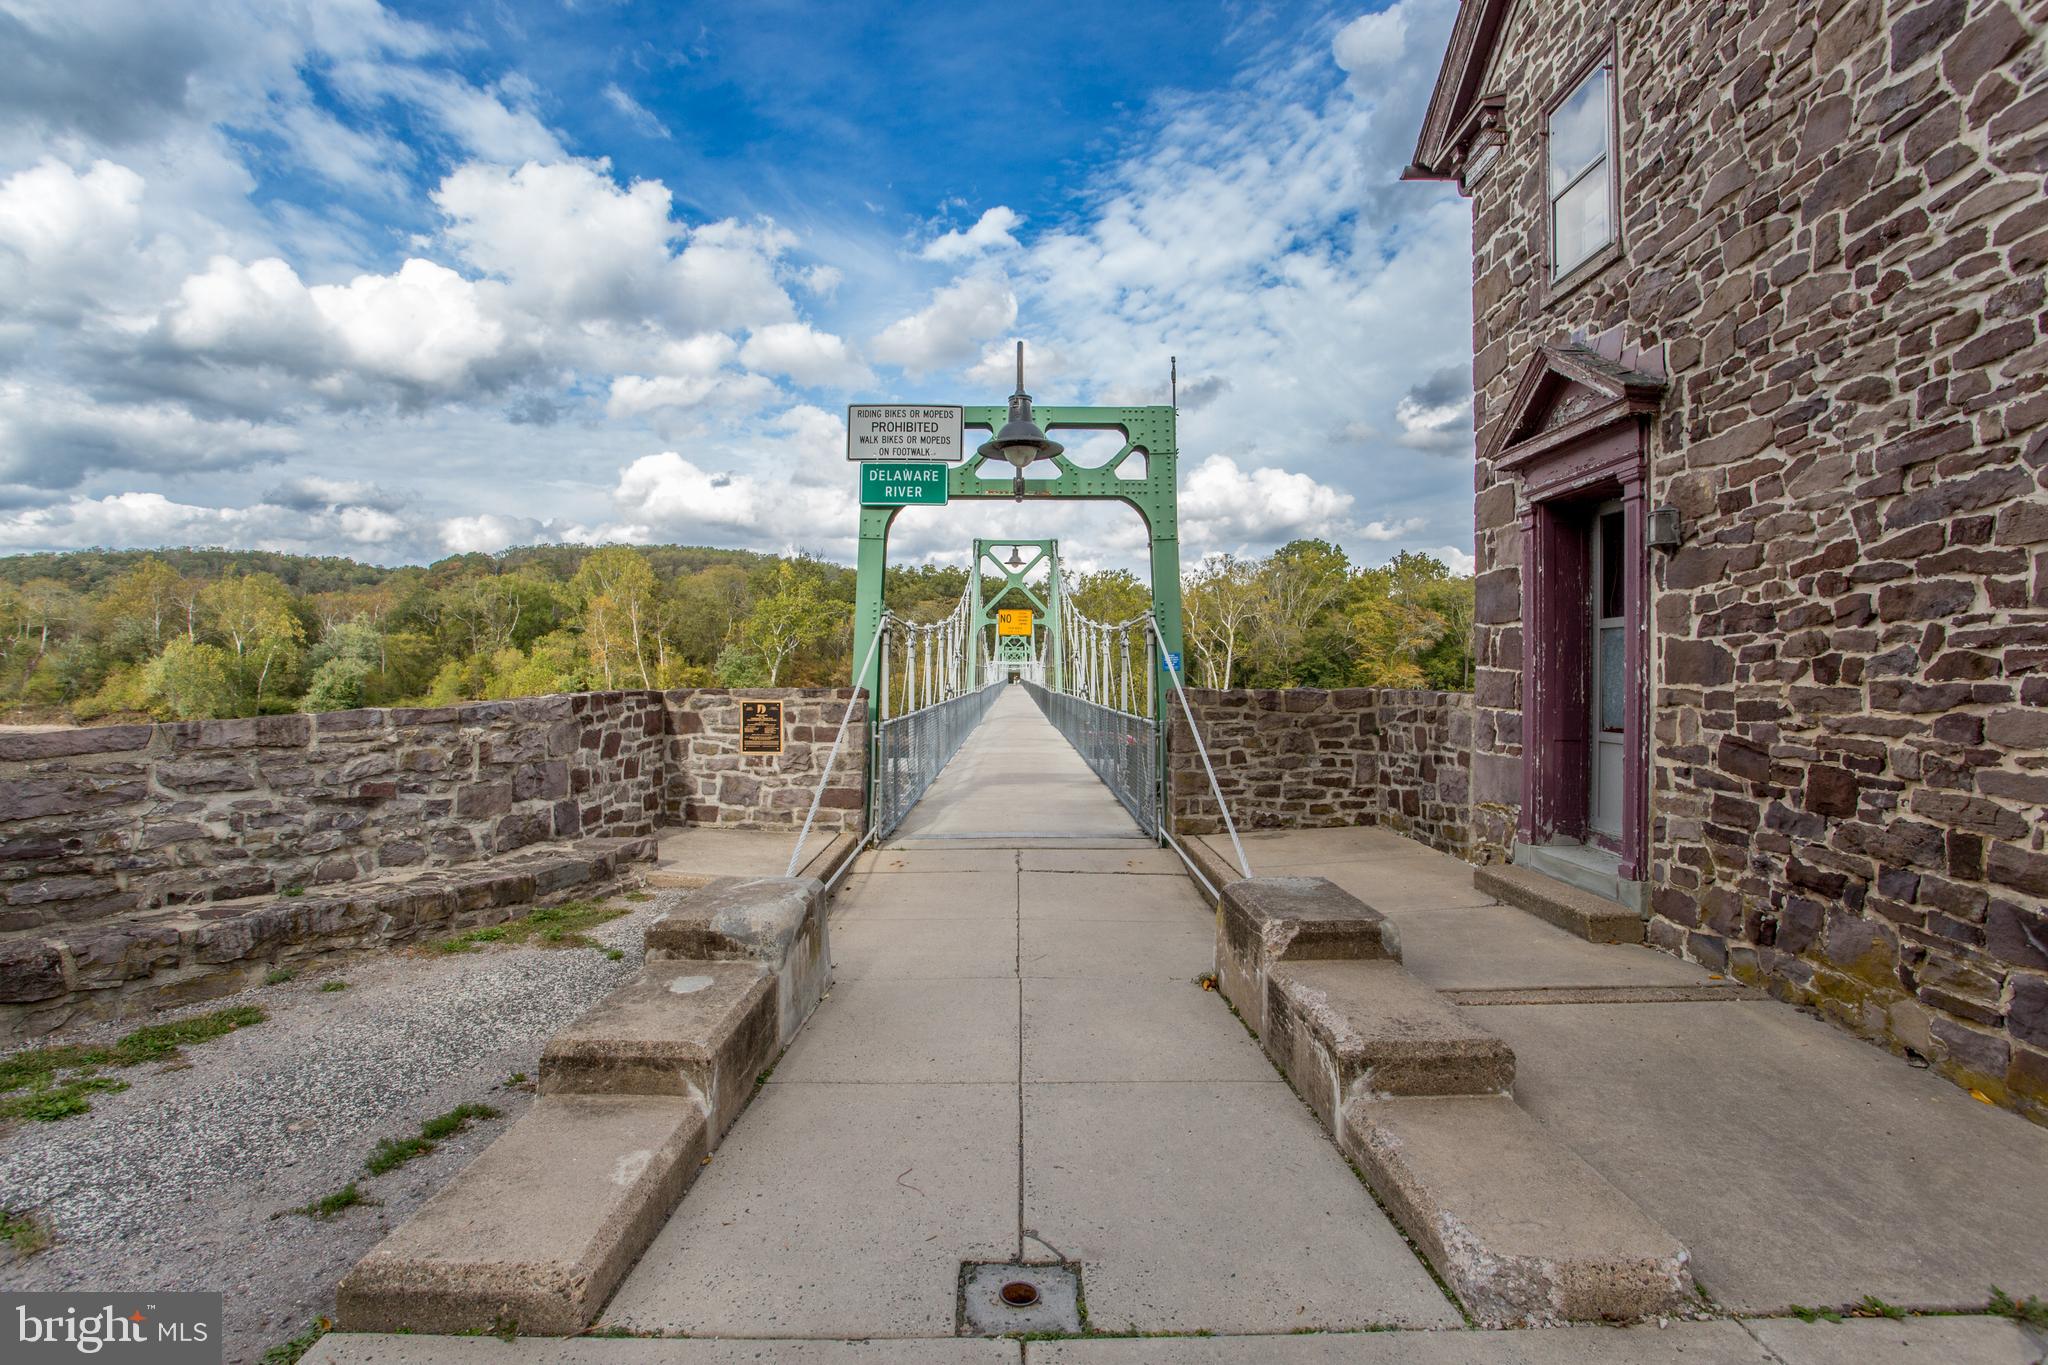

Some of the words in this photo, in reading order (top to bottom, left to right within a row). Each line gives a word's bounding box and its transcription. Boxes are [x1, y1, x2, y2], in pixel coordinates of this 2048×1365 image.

[857, 410, 882, 418] RIDING
[885, 410, 907, 418] BIKES
[909, 410, 920, 418] OR
[923, 410, 954, 419] MOPEDS
[871, 422, 939, 433] PROHIBITED
[859, 435, 879, 444] WALK
[881, 436, 904, 444] BIKES
[906, 436, 917, 444] OR
[920, 436, 951, 445] MOPEDS
[879, 448, 890, 456] ON
[892, 448, 930, 457] FOOTWALK
[869, 470, 939, 482] DELAWARE
[885, 486, 922, 498] RIVER
[1000, 614, 1012, 624] NO
